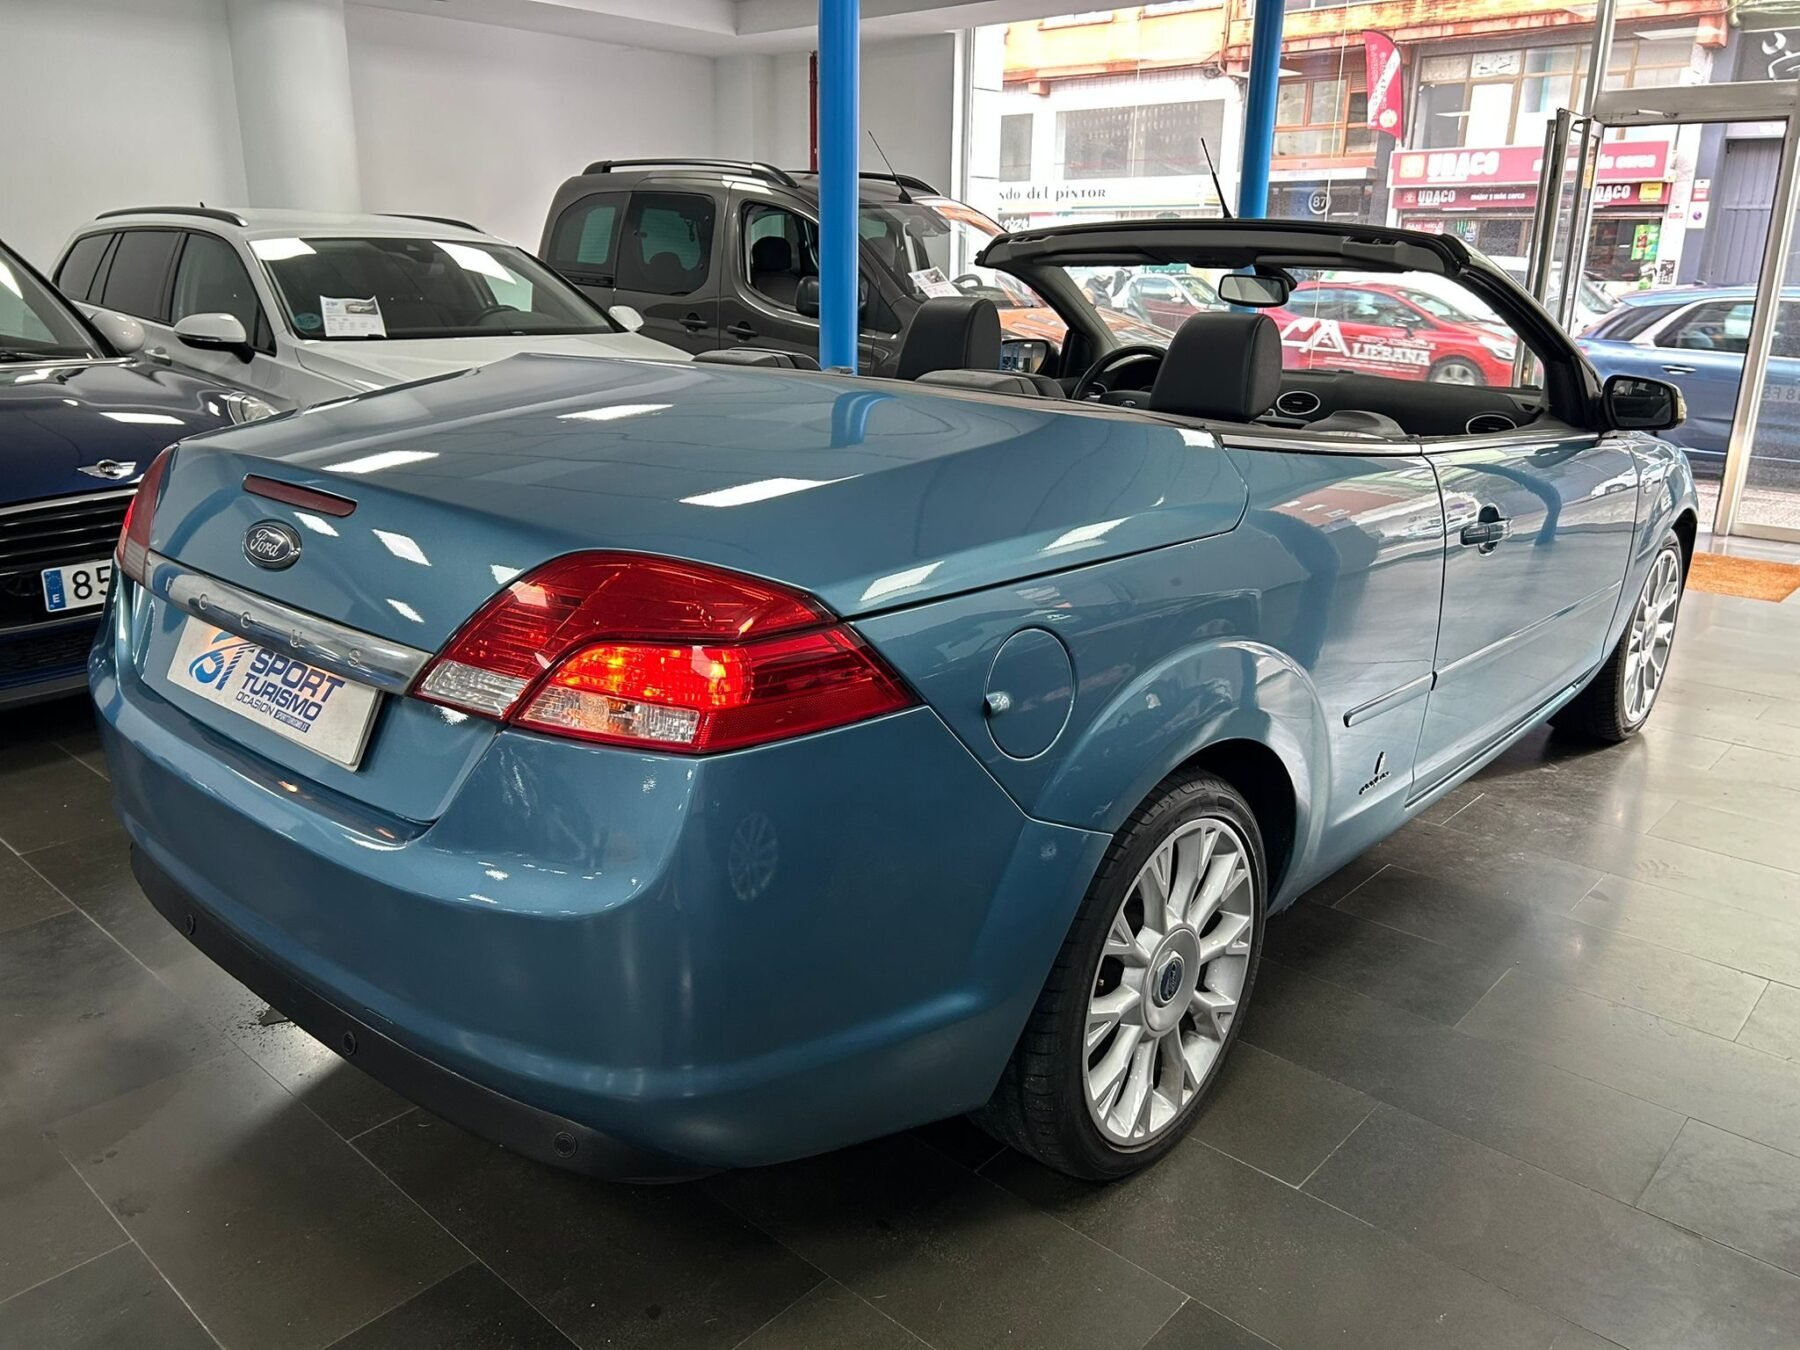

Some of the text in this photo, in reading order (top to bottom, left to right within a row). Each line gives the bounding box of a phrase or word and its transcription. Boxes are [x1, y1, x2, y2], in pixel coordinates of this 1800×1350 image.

[1427, 151, 1500, 177] UDACO
[1312, 196, 1327, 207] 87
[1418, 190, 1456, 203] UDACO
[1595, 185, 1631, 202] DACO
[250, 529, 285, 557] Ford
[52, 593, 61, 604] E
[249, 647, 345, 702] SPORT
[236, 692, 275, 717] OCASION
[241, 673, 323, 721] TURISMO
